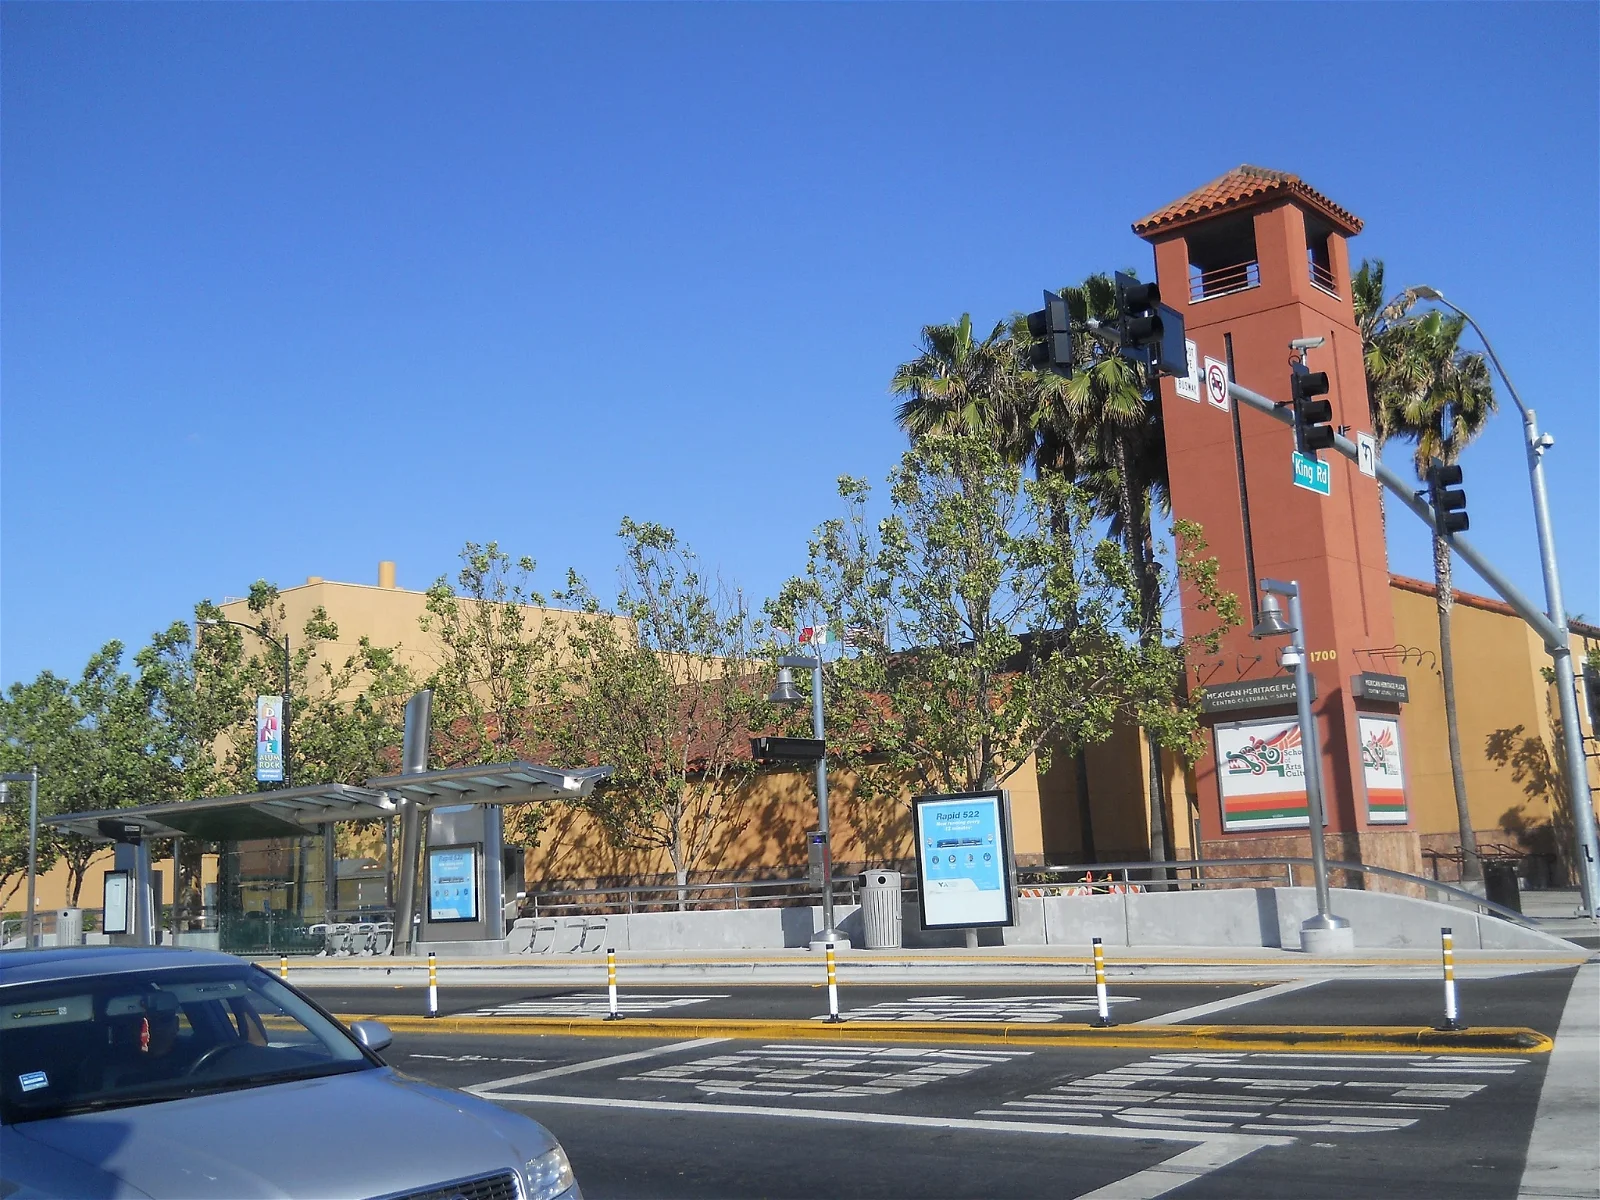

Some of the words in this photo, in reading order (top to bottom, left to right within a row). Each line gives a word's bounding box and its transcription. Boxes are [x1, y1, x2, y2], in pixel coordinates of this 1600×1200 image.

[1295, 457, 1313, 484] King
[1316, 465, 1328, 484] Rd
[1310, 650, 1337, 662] 1700
[1206, 690, 1242, 700] MEXICAN
[1243, 684, 1280, 695] HERITAGE
[1281, 683, 1297, 691] PLA
[1237, 695, 1269, 703] CULTURAL
[264, 707, 275, 753] DINE
[936, 811, 961, 821] Rapid
[962, 810, 980, 819] 522
[616, 1044, 1036, 1098] KEEP
[974, 1052, 1532, 1133] CLEAR
